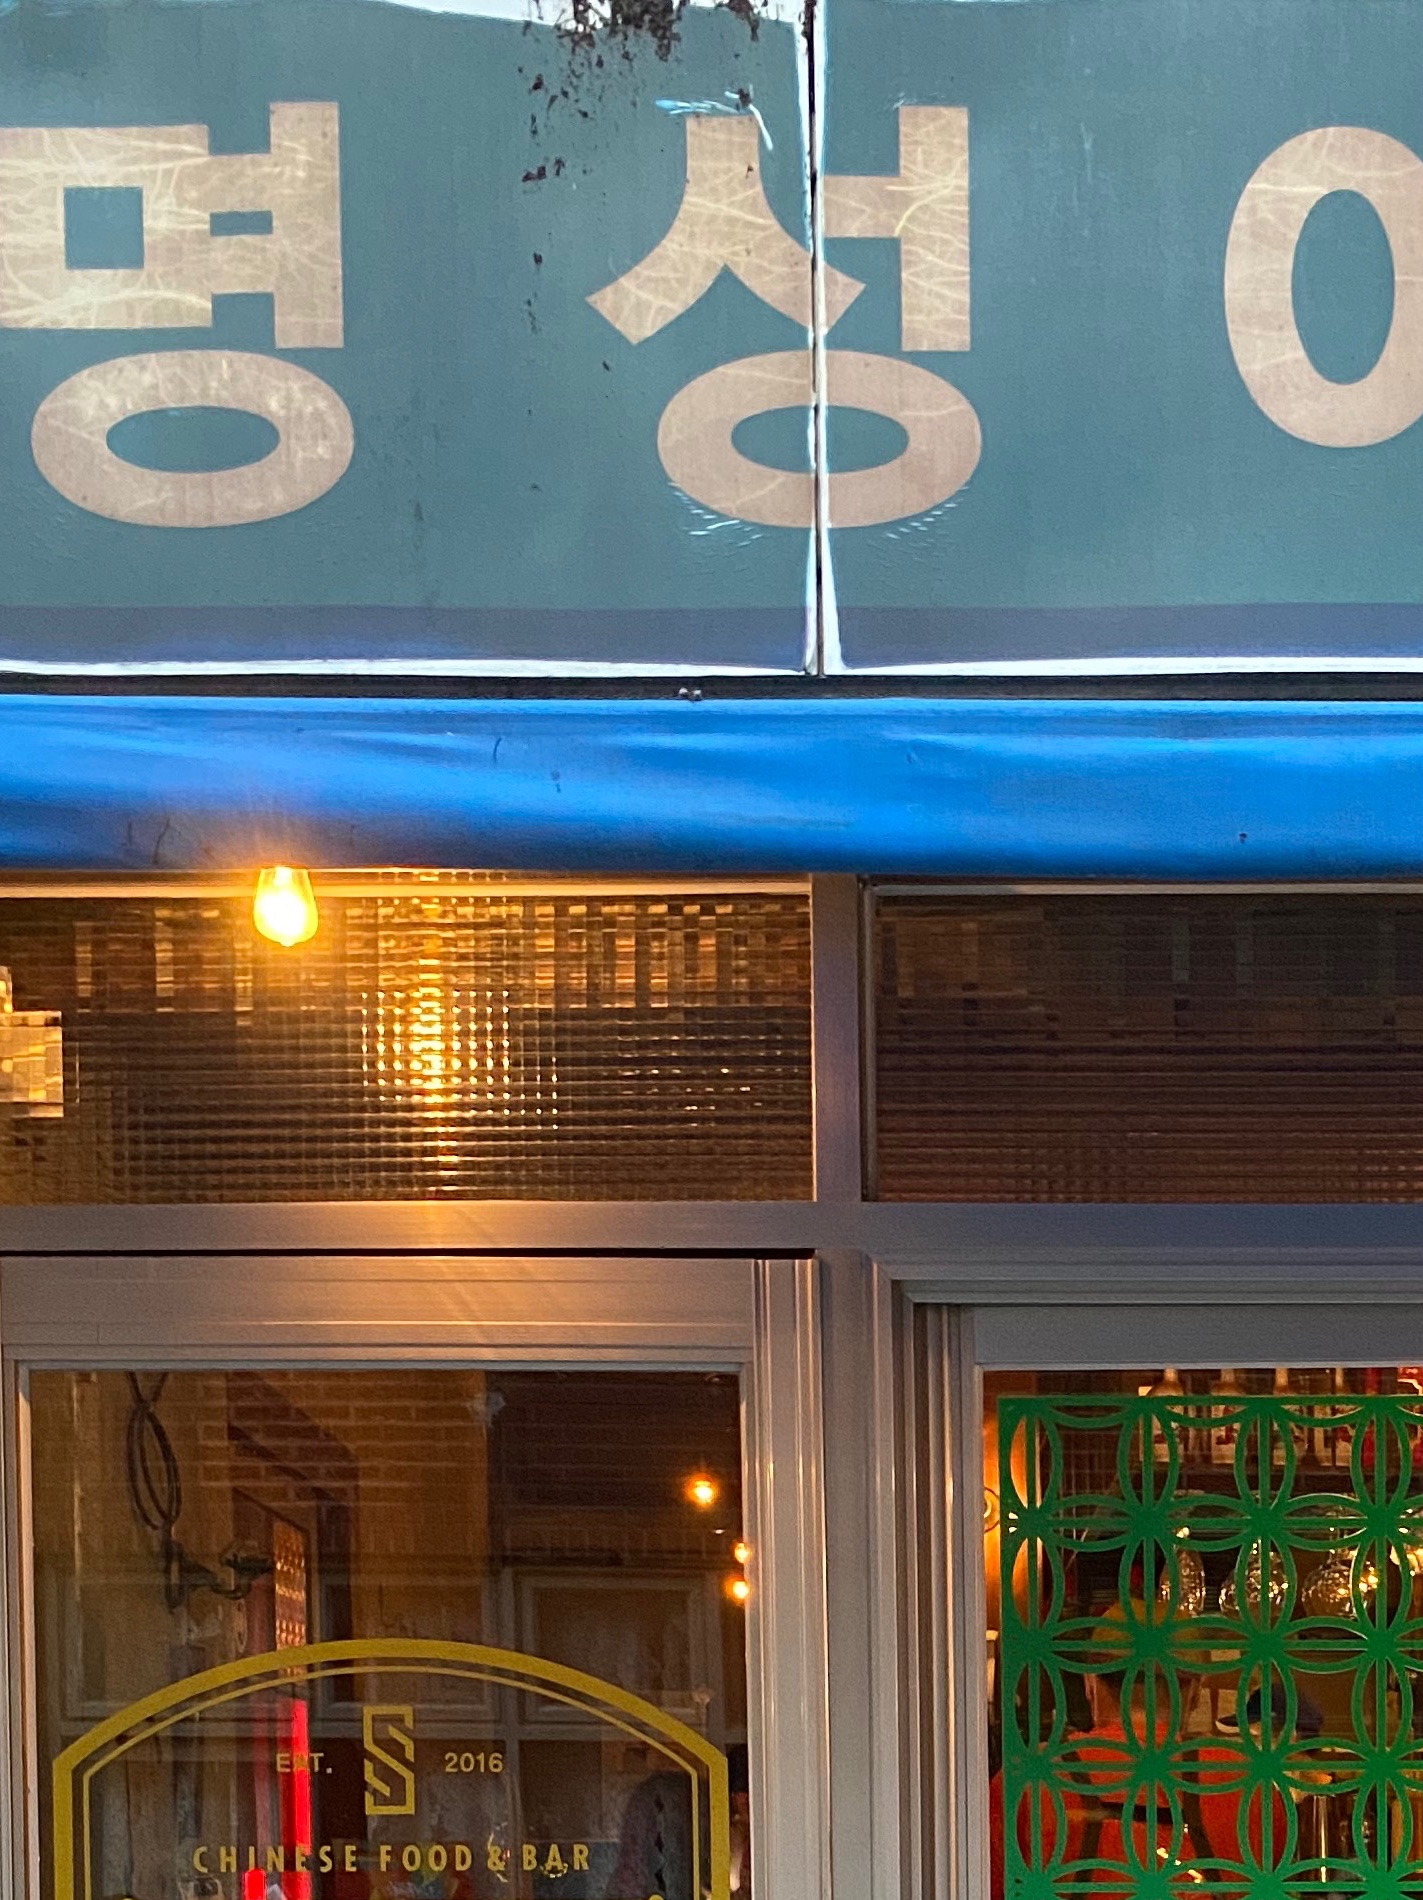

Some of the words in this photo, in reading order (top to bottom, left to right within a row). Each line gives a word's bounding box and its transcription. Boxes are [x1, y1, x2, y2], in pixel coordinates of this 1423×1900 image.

[276, 1752, 333, 1774] ET.
[445, 1752, 503, 1773] 2016
[193, 1845, 357, 1873] CHINESE
[380, 1844, 472, 1872] FOOD
[487, 1845, 505, 1871] &
[522, 1844, 589, 1871] BAR
